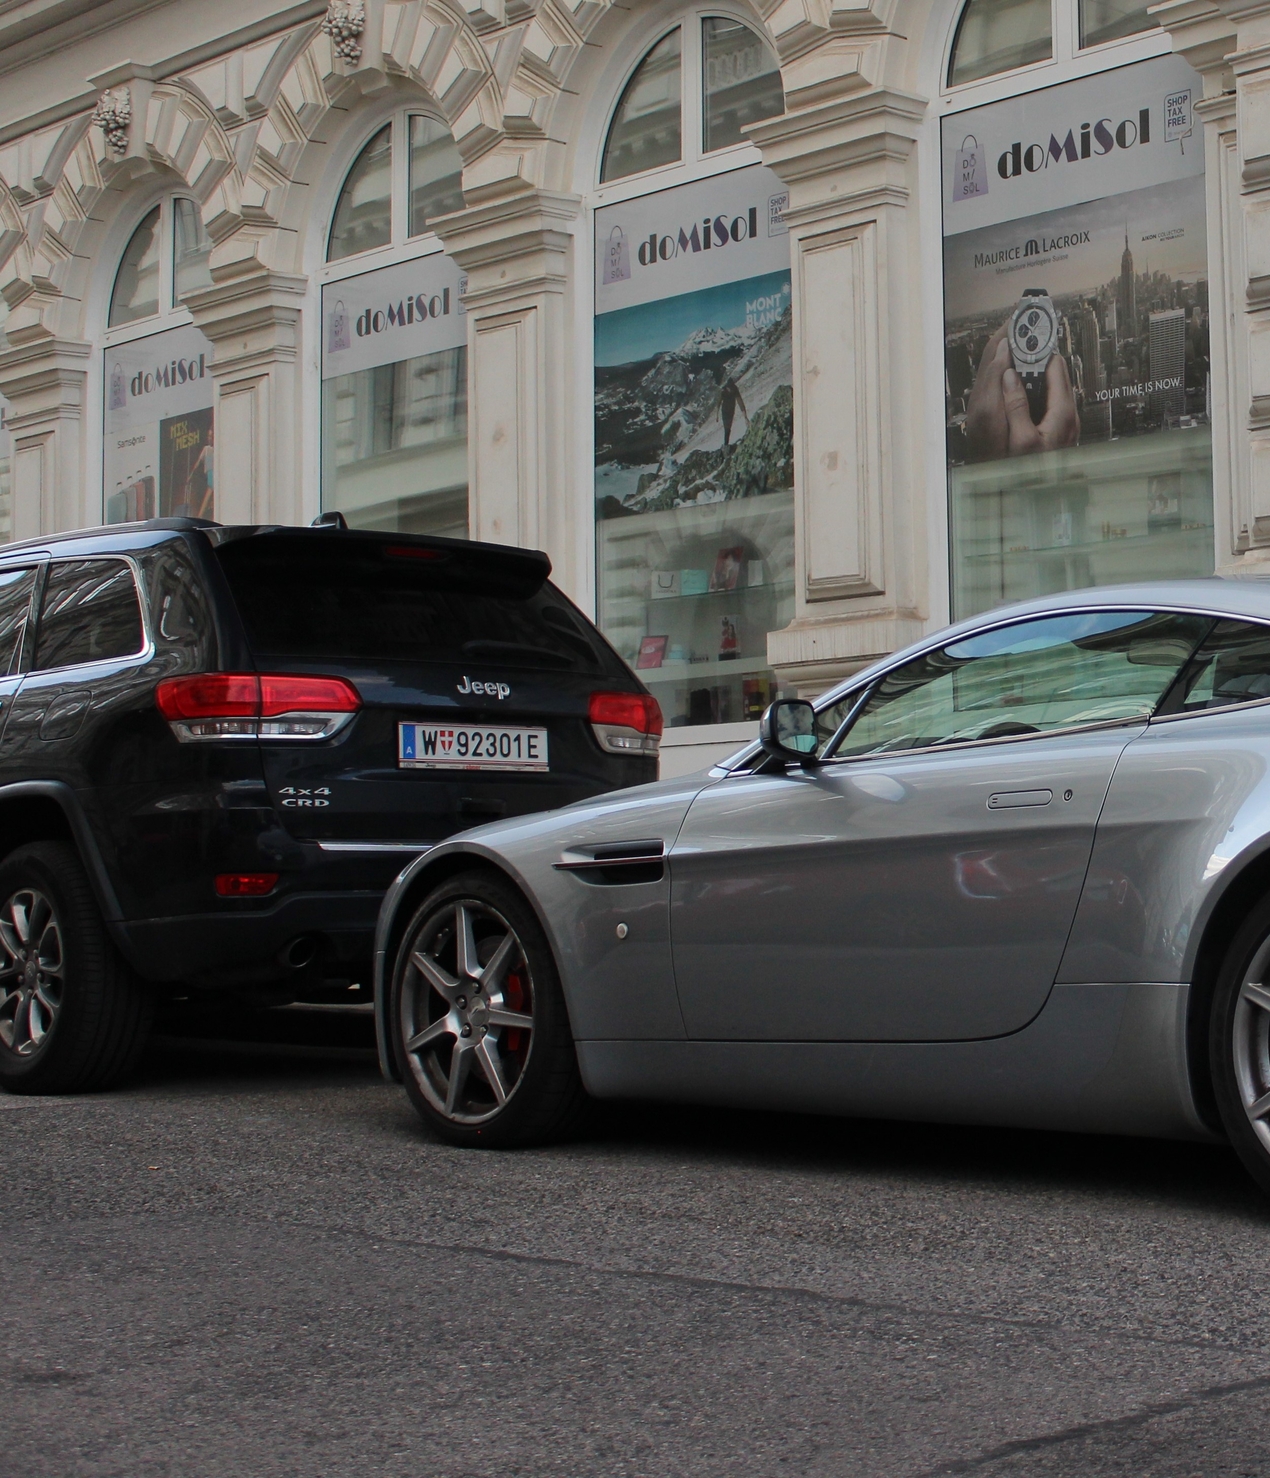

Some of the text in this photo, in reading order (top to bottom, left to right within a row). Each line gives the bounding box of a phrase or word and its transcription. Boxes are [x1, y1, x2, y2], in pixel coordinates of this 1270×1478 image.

[1167, 95, 1188, 108] SHOP
[1167, 106, 1183, 117] TAX
[1167, 115, 1186, 128] FREE
[997, 108, 1150, 179] doMiSol
[770, 196, 787, 208] SHOP
[638, 207, 757, 266] doMiSol
[356, 287, 450, 337] doMiSol
[746, 292, 782, 314] MONT
[746, 307, 782, 328] BLANC
[131, 353, 206, 397] doMiSol
[1095, 377, 1182, 401] YOUR TIME IS NOW.
[457, 675, 511, 700] Jeep
[405, 730, 540, 759] A W 92301E
[278, 786, 332, 797] 4x4
[281, 798, 330, 807] CRD
